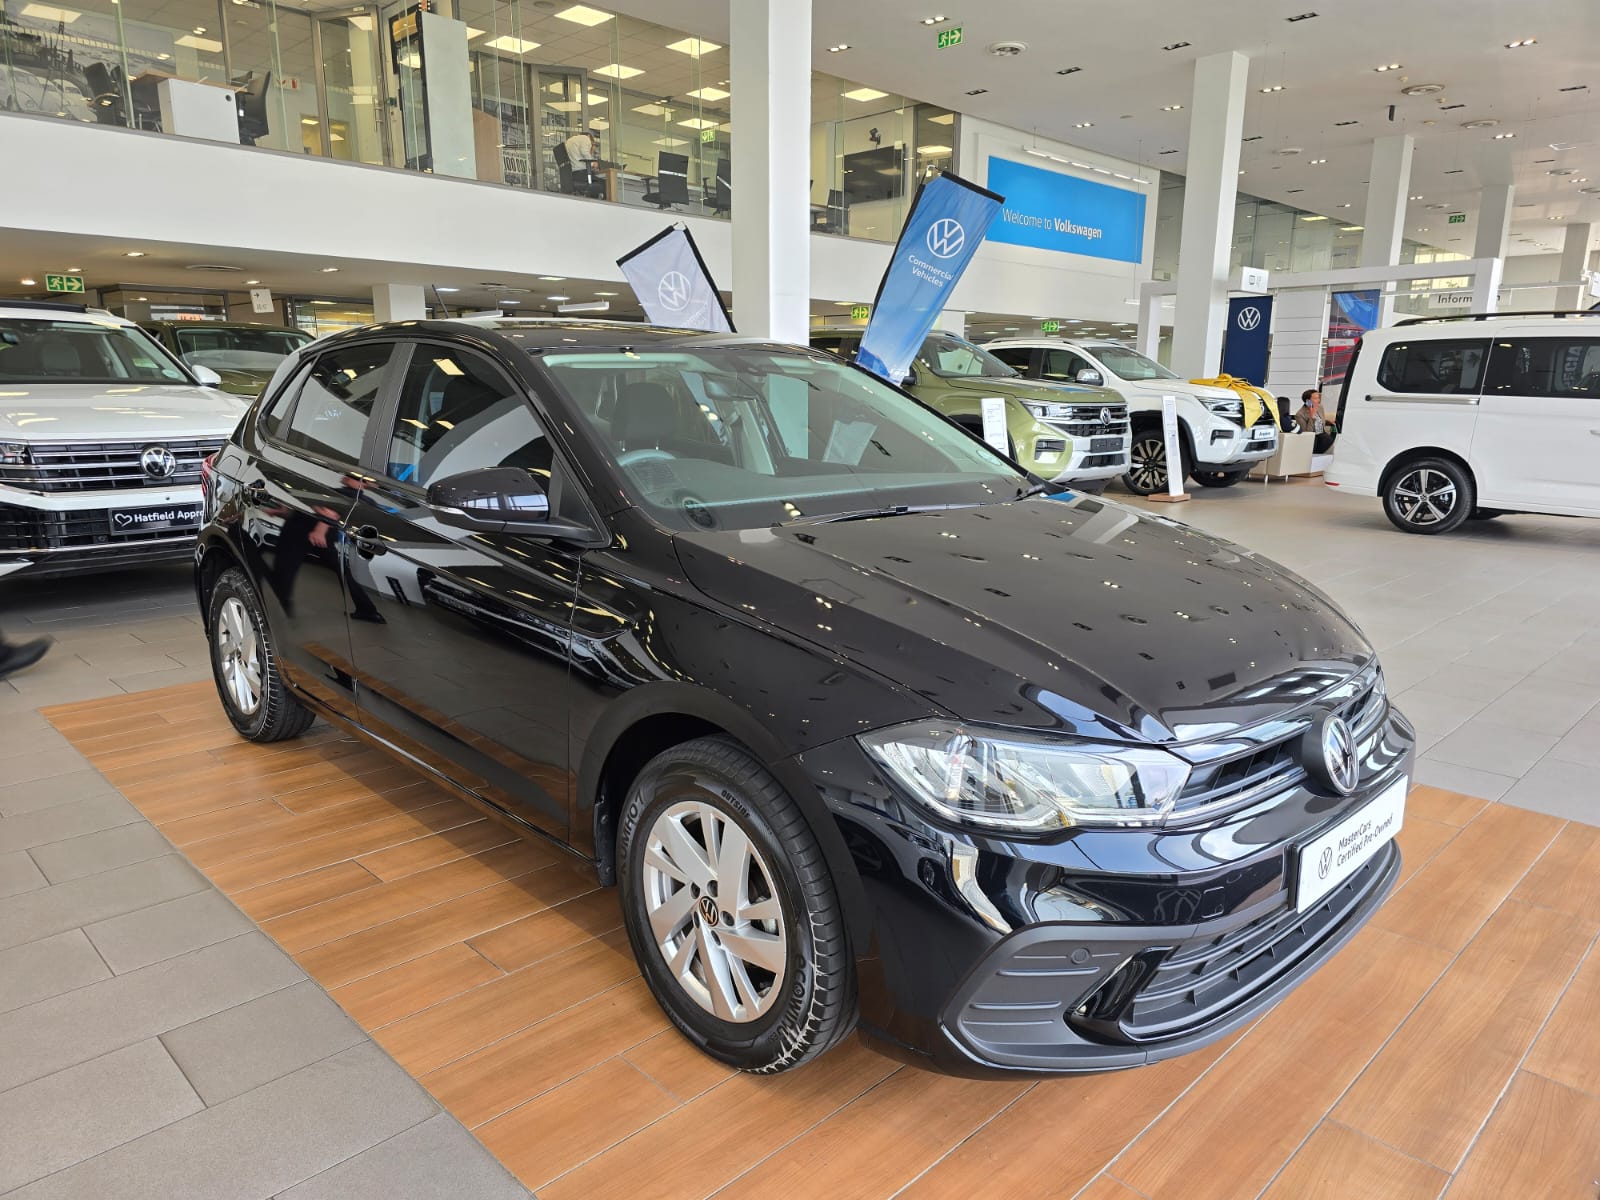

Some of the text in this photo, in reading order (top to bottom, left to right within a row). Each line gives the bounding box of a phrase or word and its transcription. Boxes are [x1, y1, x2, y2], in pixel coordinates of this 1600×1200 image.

[1002, 207, 1102, 240] Welcome to Volkswagen
[912, 266, 944, 288] Vehicles
[134, 509, 204, 523] Hatfield Appro
[720, 790, 751, 819] OUTSIDE
[1336, 812, 1393, 867] Certified Pre-Owned
[1338, 819, 1372, 851] MasterCars
